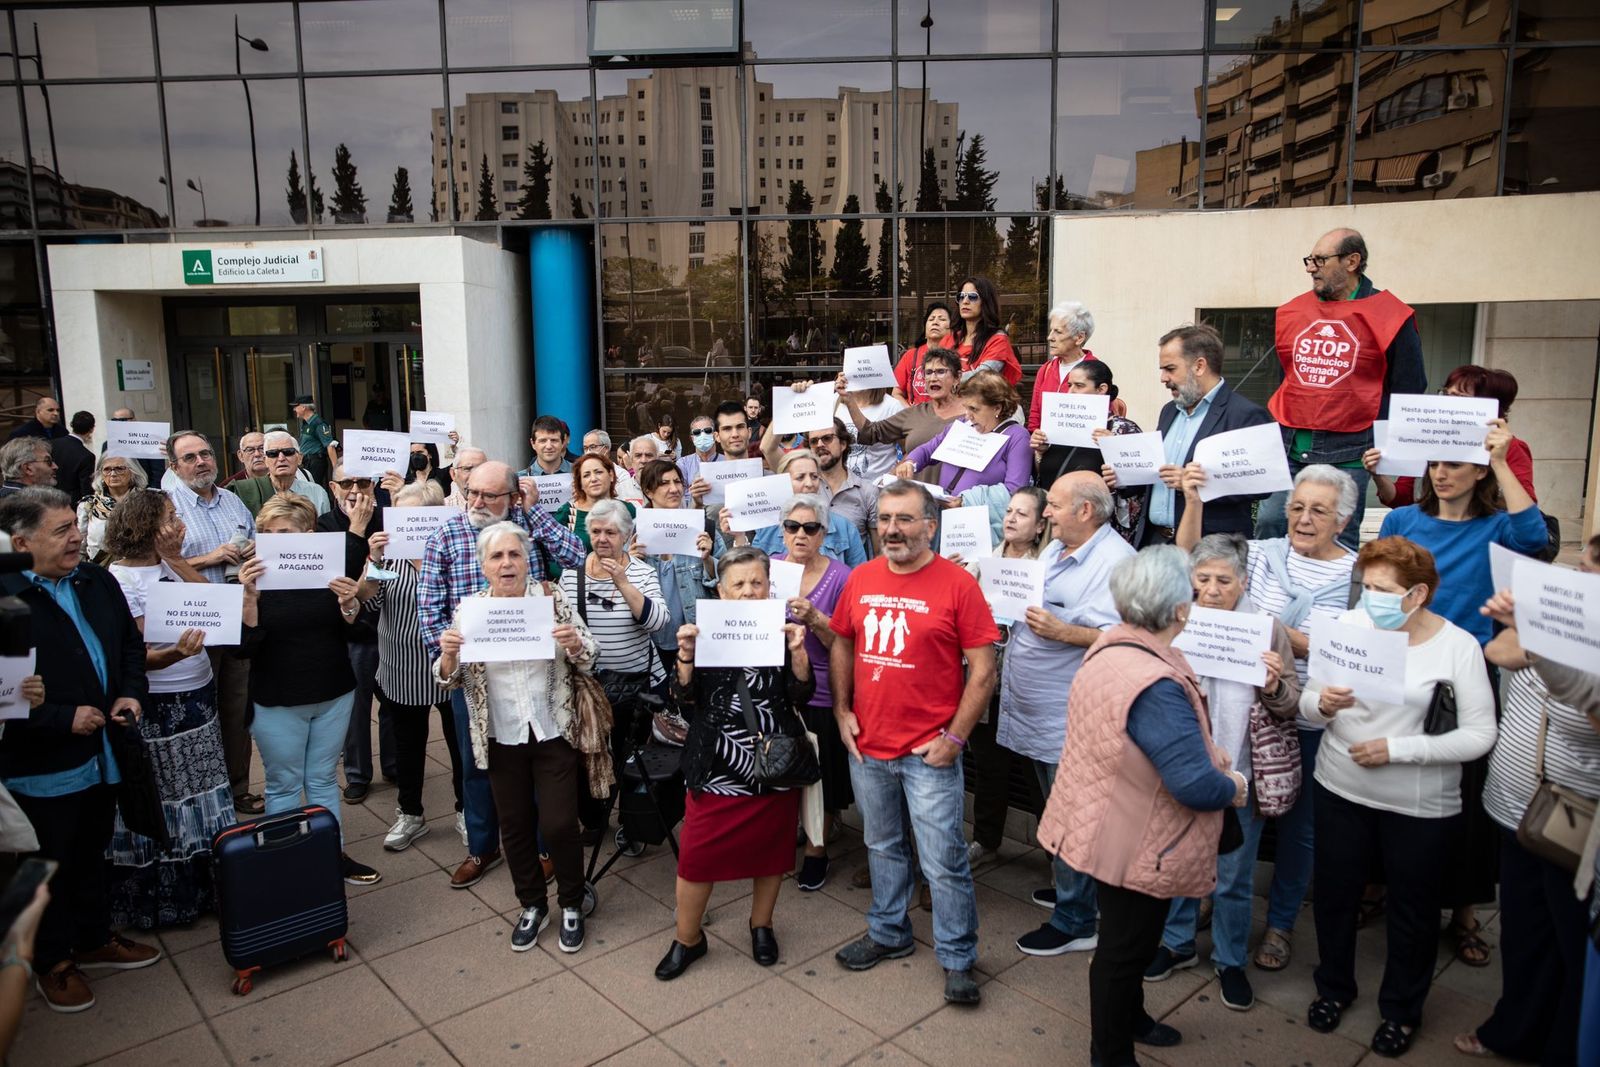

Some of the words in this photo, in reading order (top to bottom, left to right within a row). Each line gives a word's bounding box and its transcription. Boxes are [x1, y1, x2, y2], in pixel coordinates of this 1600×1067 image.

[217, 256, 261, 267] Complejo
[263, 255, 300, 265] Judicial
[218, 268, 246, 276] Edificio
[256, 267, 280, 275] Caleta
[1298, 338, 1351, 358] STOP
[1295, 353, 1350, 368] Desahucios
[1299, 363, 1340, 377] Granada
[1307, 374, 1318, 383] 15
[1318, 375, 1327, 384] M
[1401, 406, 1421, 414] Hasta
[1439, 409, 1474, 417] tengamos
[1064, 413, 1097, 421] IMPUNIDAD
[1417, 416, 1437, 424] todos
[1439, 417, 1449, 425] los
[1451, 418, 1478, 427] barrios,
[1432, 428, 1461, 436] pongáis
[1452, 439, 1483, 447] Navidad
[1130, 450, 1141, 458] LUZ
[1231, 447, 1249, 456] SED,
[360, 455, 396, 463] APAGANDO
[715, 472, 748, 480] QUEREMOS
[1223, 468, 1267, 479] OSCURIDAD
[748, 506, 782, 515] OSCURIDAD
[652, 522, 688, 530] QUEREMOS
[278, 563, 324, 571] APAGANDO
[202, 611, 222, 619] LUJO,
[188, 620, 222, 628] DERECHO
[724, 619, 737, 628] NO
[738, 619, 758, 628] MAS
[1214, 623, 1249, 634] tengamos
[711, 632, 741, 641] CORTES
[743, 633, 753, 641] DE
[755, 632, 770, 641] LUZ
[1193, 630, 1213, 638] todos
[1214, 632, 1225, 640] los
[1330, 640, 1343, 651] NO
[1344, 645, 1368, 658] MAS
[1227, 657, 1257, 668] Navidad
[1319, 648, 1347, 668] CORTES
[1348, 661, 1362, 671] DE
[1364, 664, 1385, 676] LUZ
